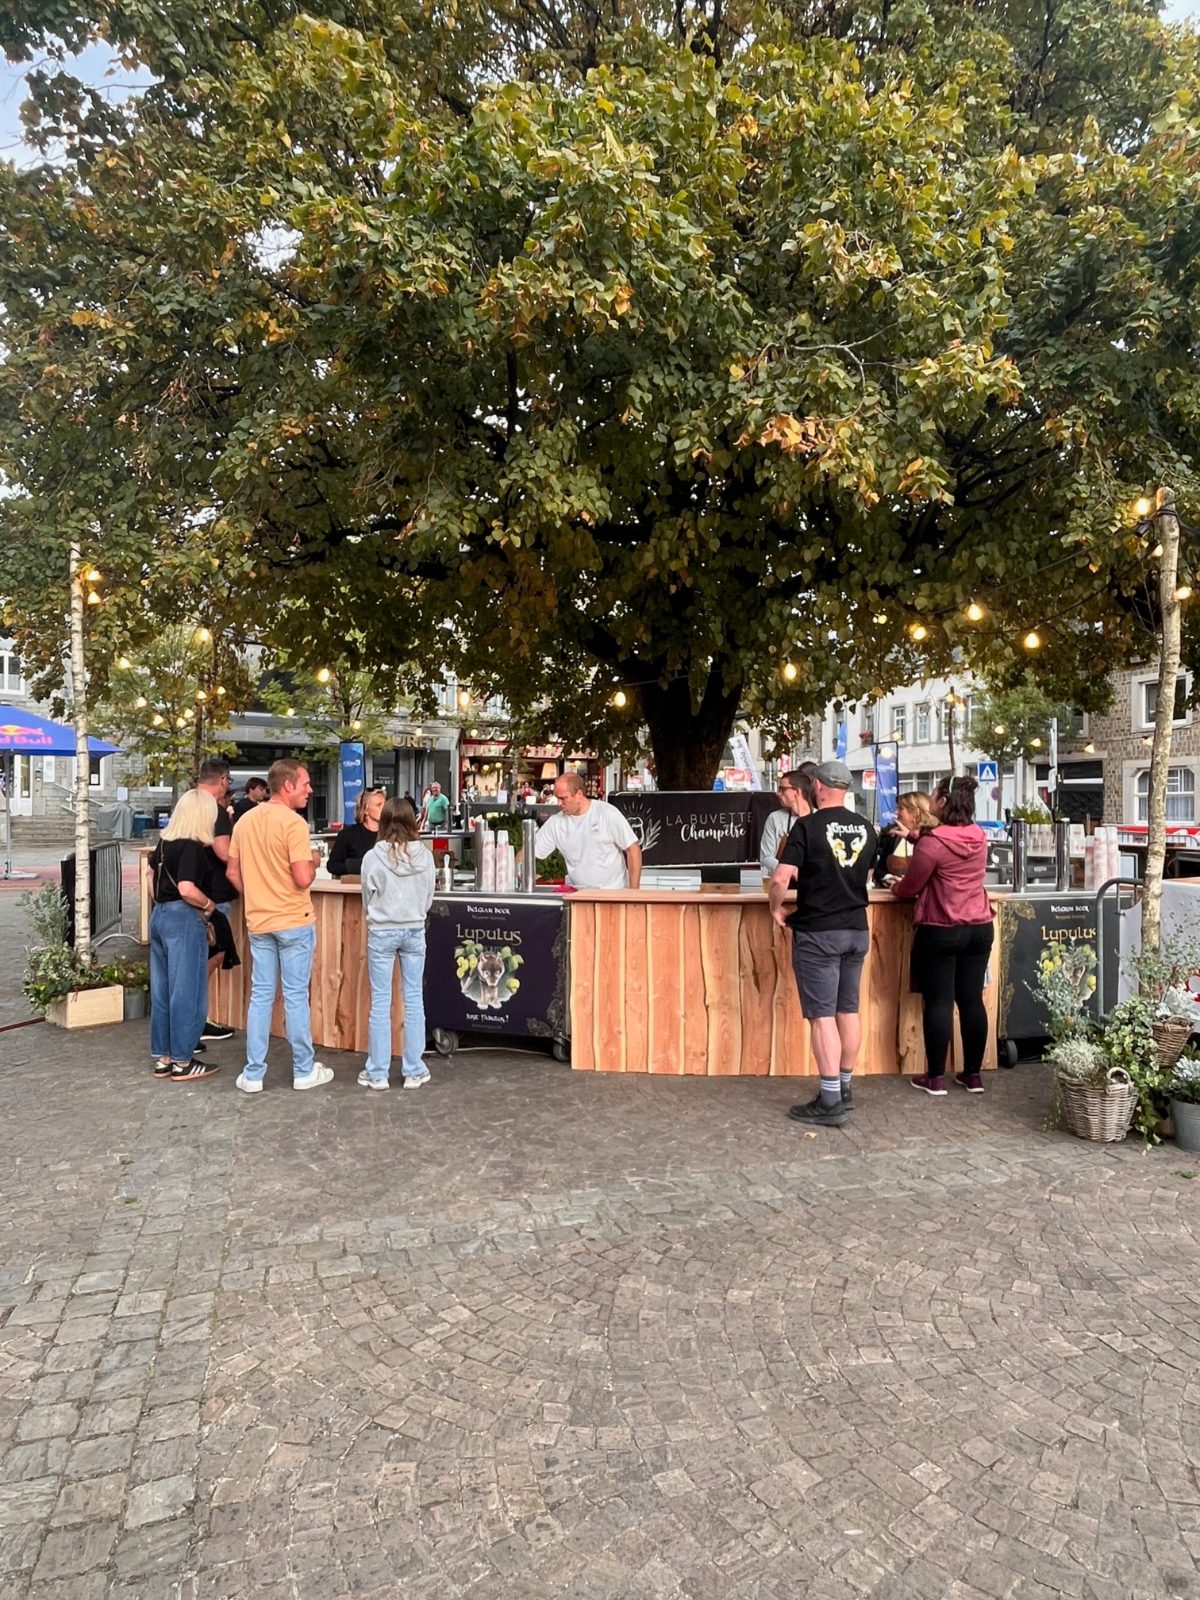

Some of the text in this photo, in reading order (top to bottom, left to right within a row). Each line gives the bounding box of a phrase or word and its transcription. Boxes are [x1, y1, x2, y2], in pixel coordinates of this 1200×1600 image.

[13, 736, 52, 745] Bull
[666, 811, 752, 826] LA BUVETTE
